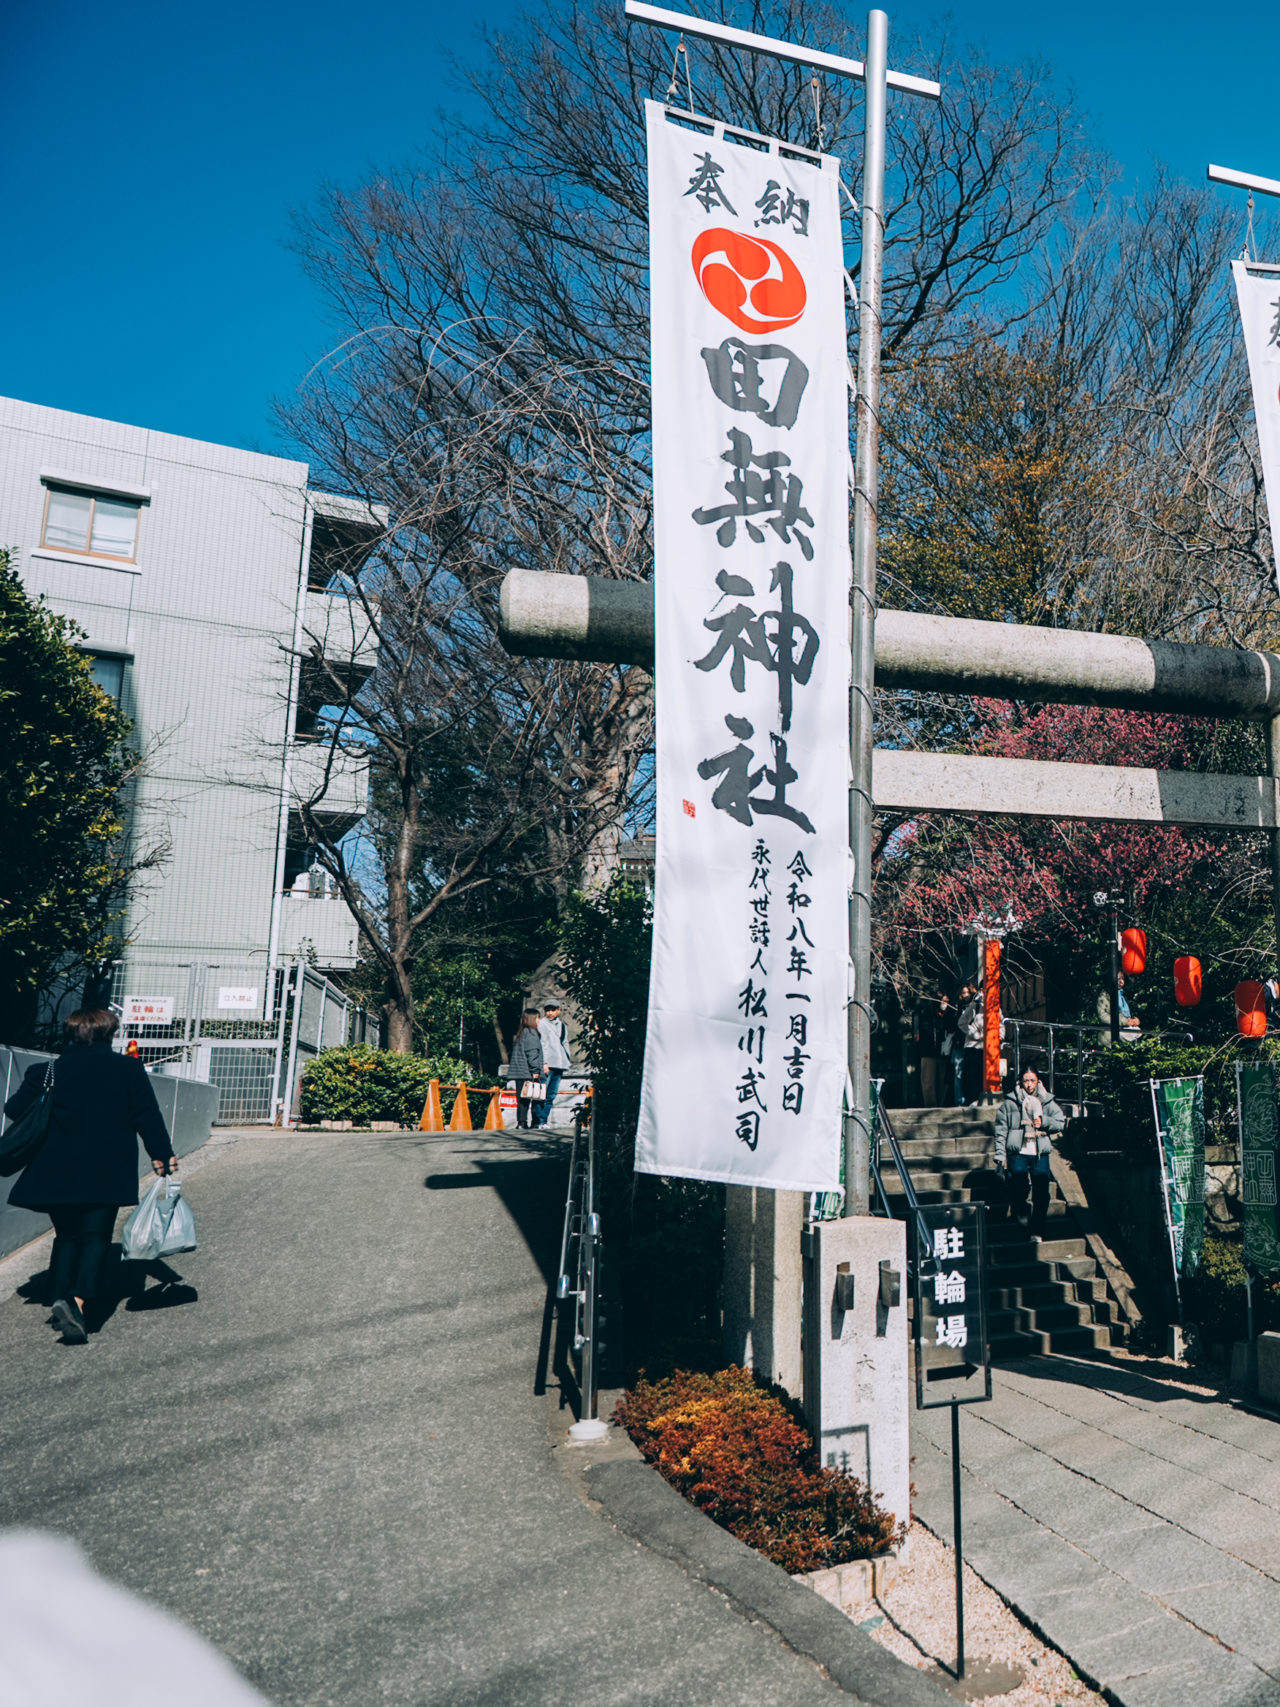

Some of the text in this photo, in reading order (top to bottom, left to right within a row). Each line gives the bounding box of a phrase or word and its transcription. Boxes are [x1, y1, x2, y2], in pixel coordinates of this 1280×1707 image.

[681, 151, 810, 237] 奉納
[691, 336, 819, 834] 田無神社
[782, 851, 815, 1115] 令和八年一月吉日
[933, 1226, 968, 1349] 駐輪場
